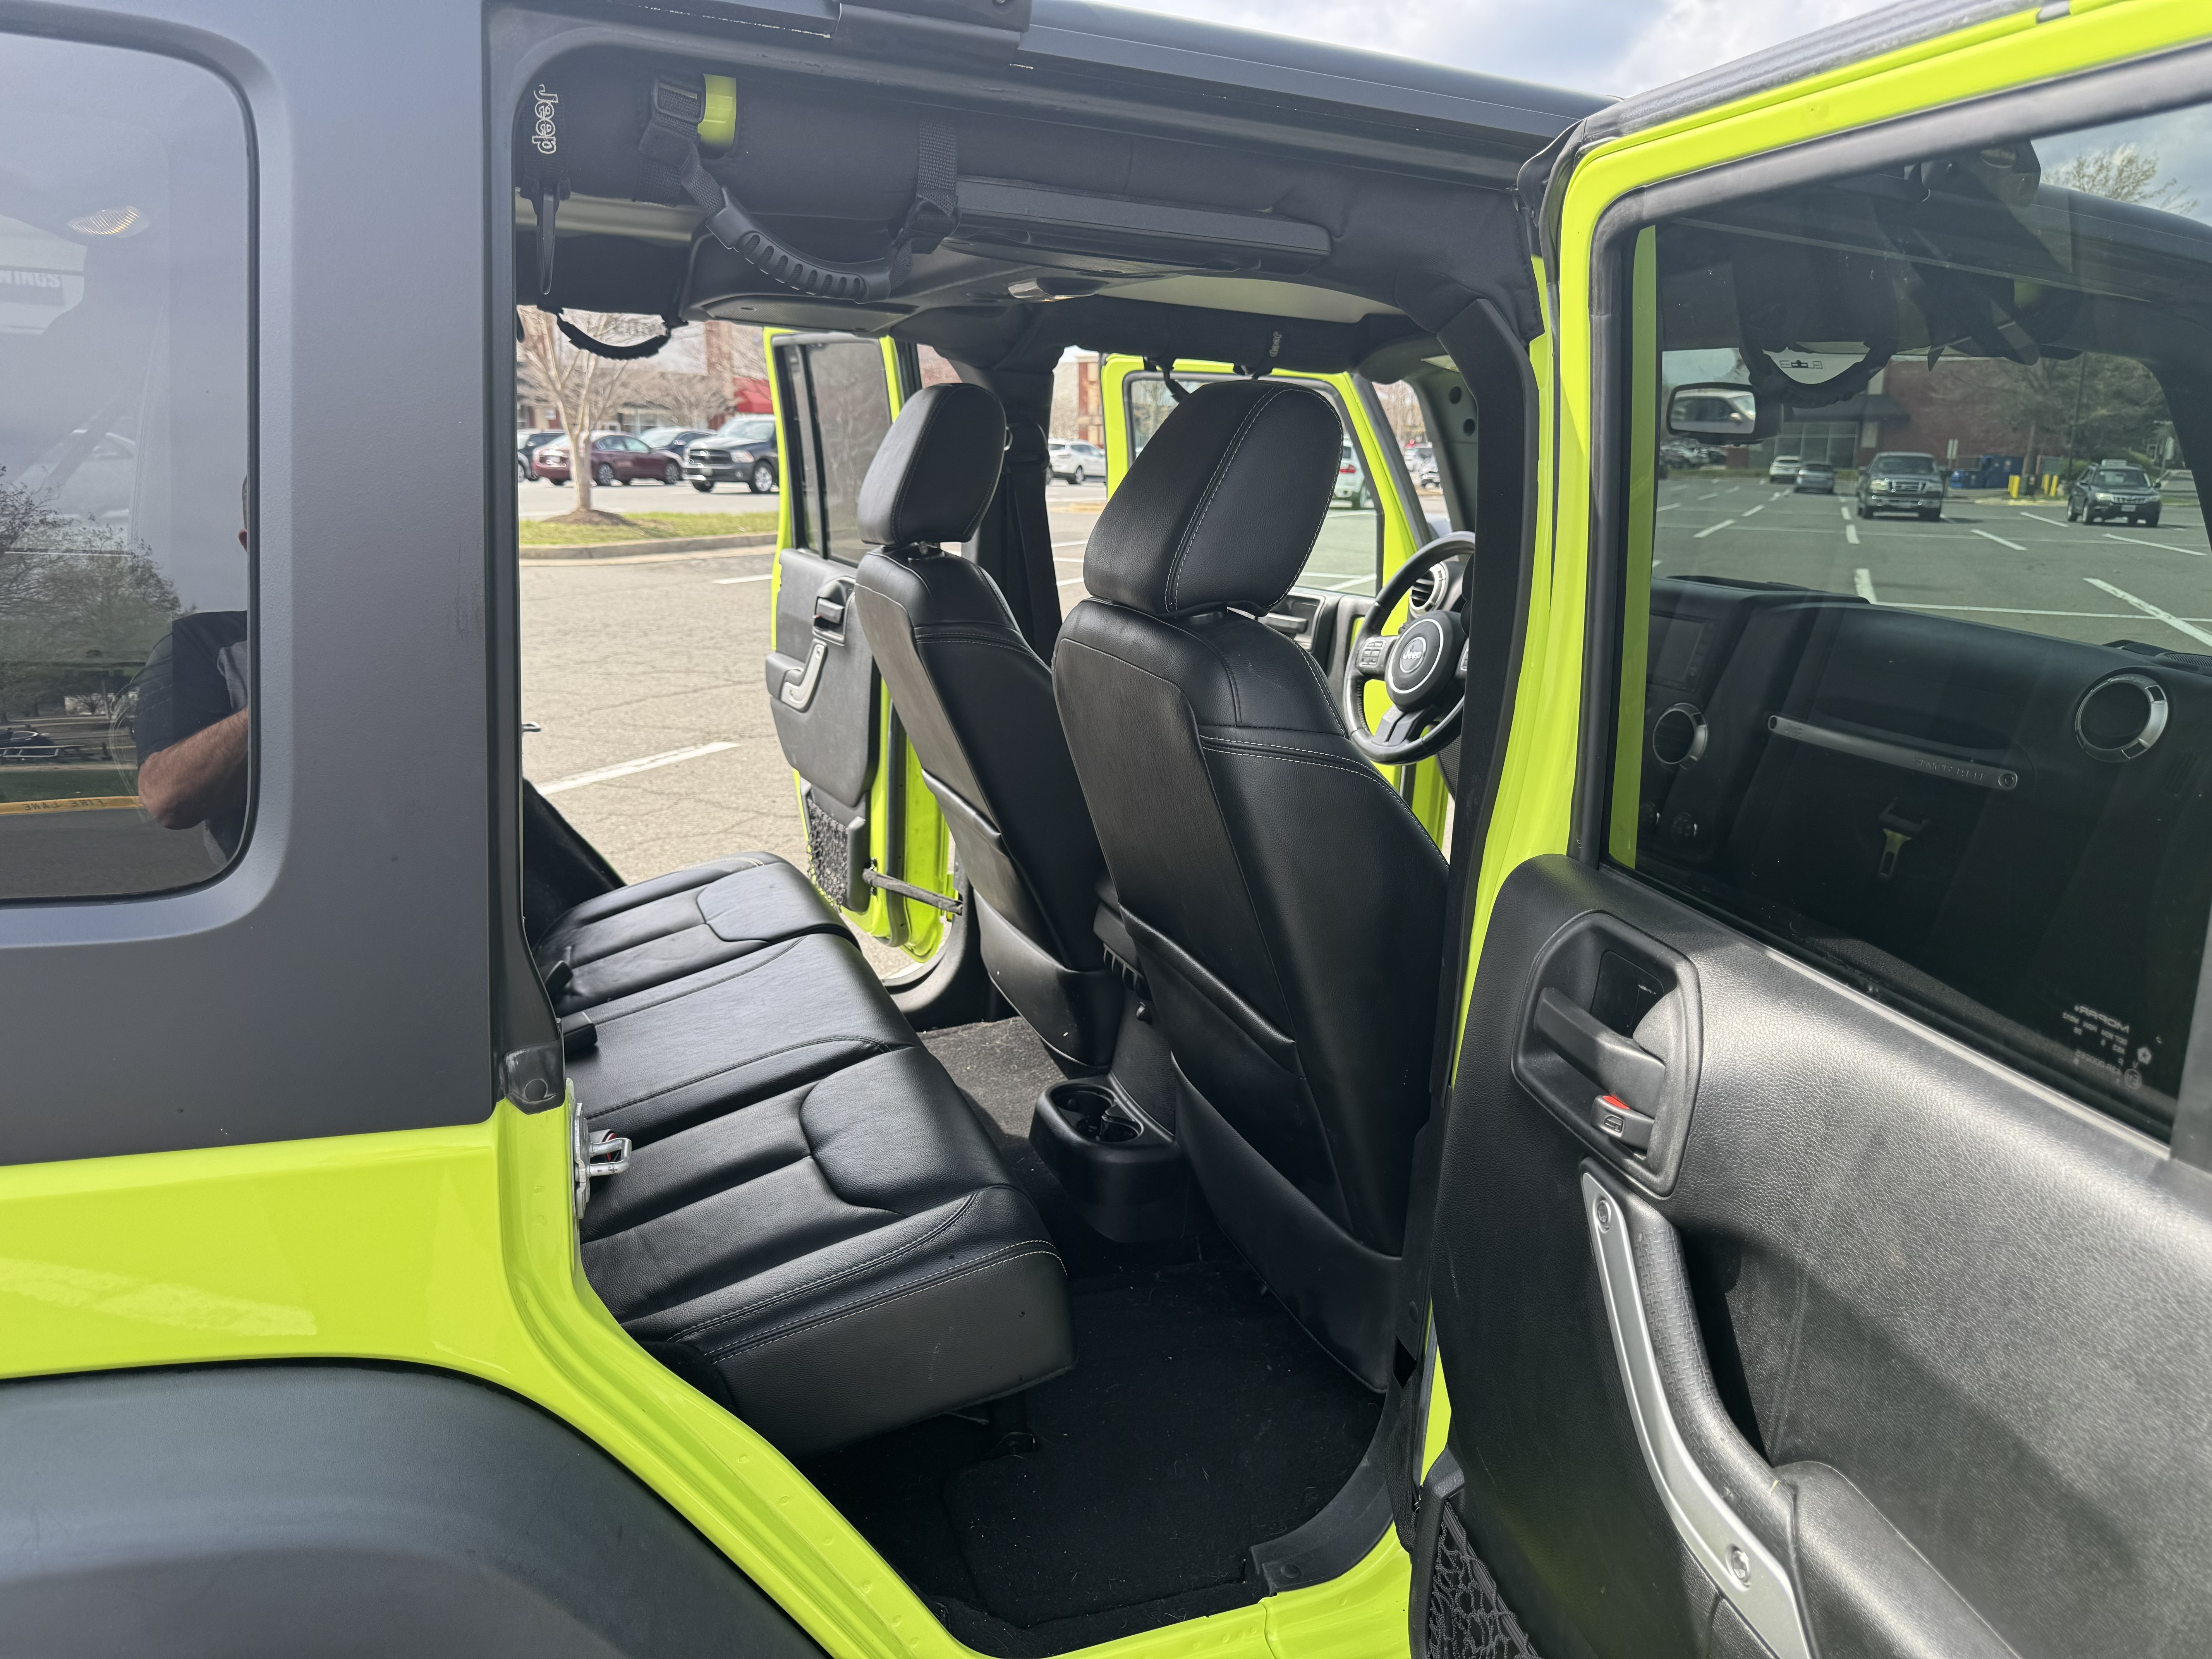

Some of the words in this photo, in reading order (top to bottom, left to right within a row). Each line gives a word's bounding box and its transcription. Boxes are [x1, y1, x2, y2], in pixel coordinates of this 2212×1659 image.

[532, 84, 558, 155] Jeep
[1269, 331, 1282, 357] Jeep
[1403, 649, 1422, 660] Jeep
